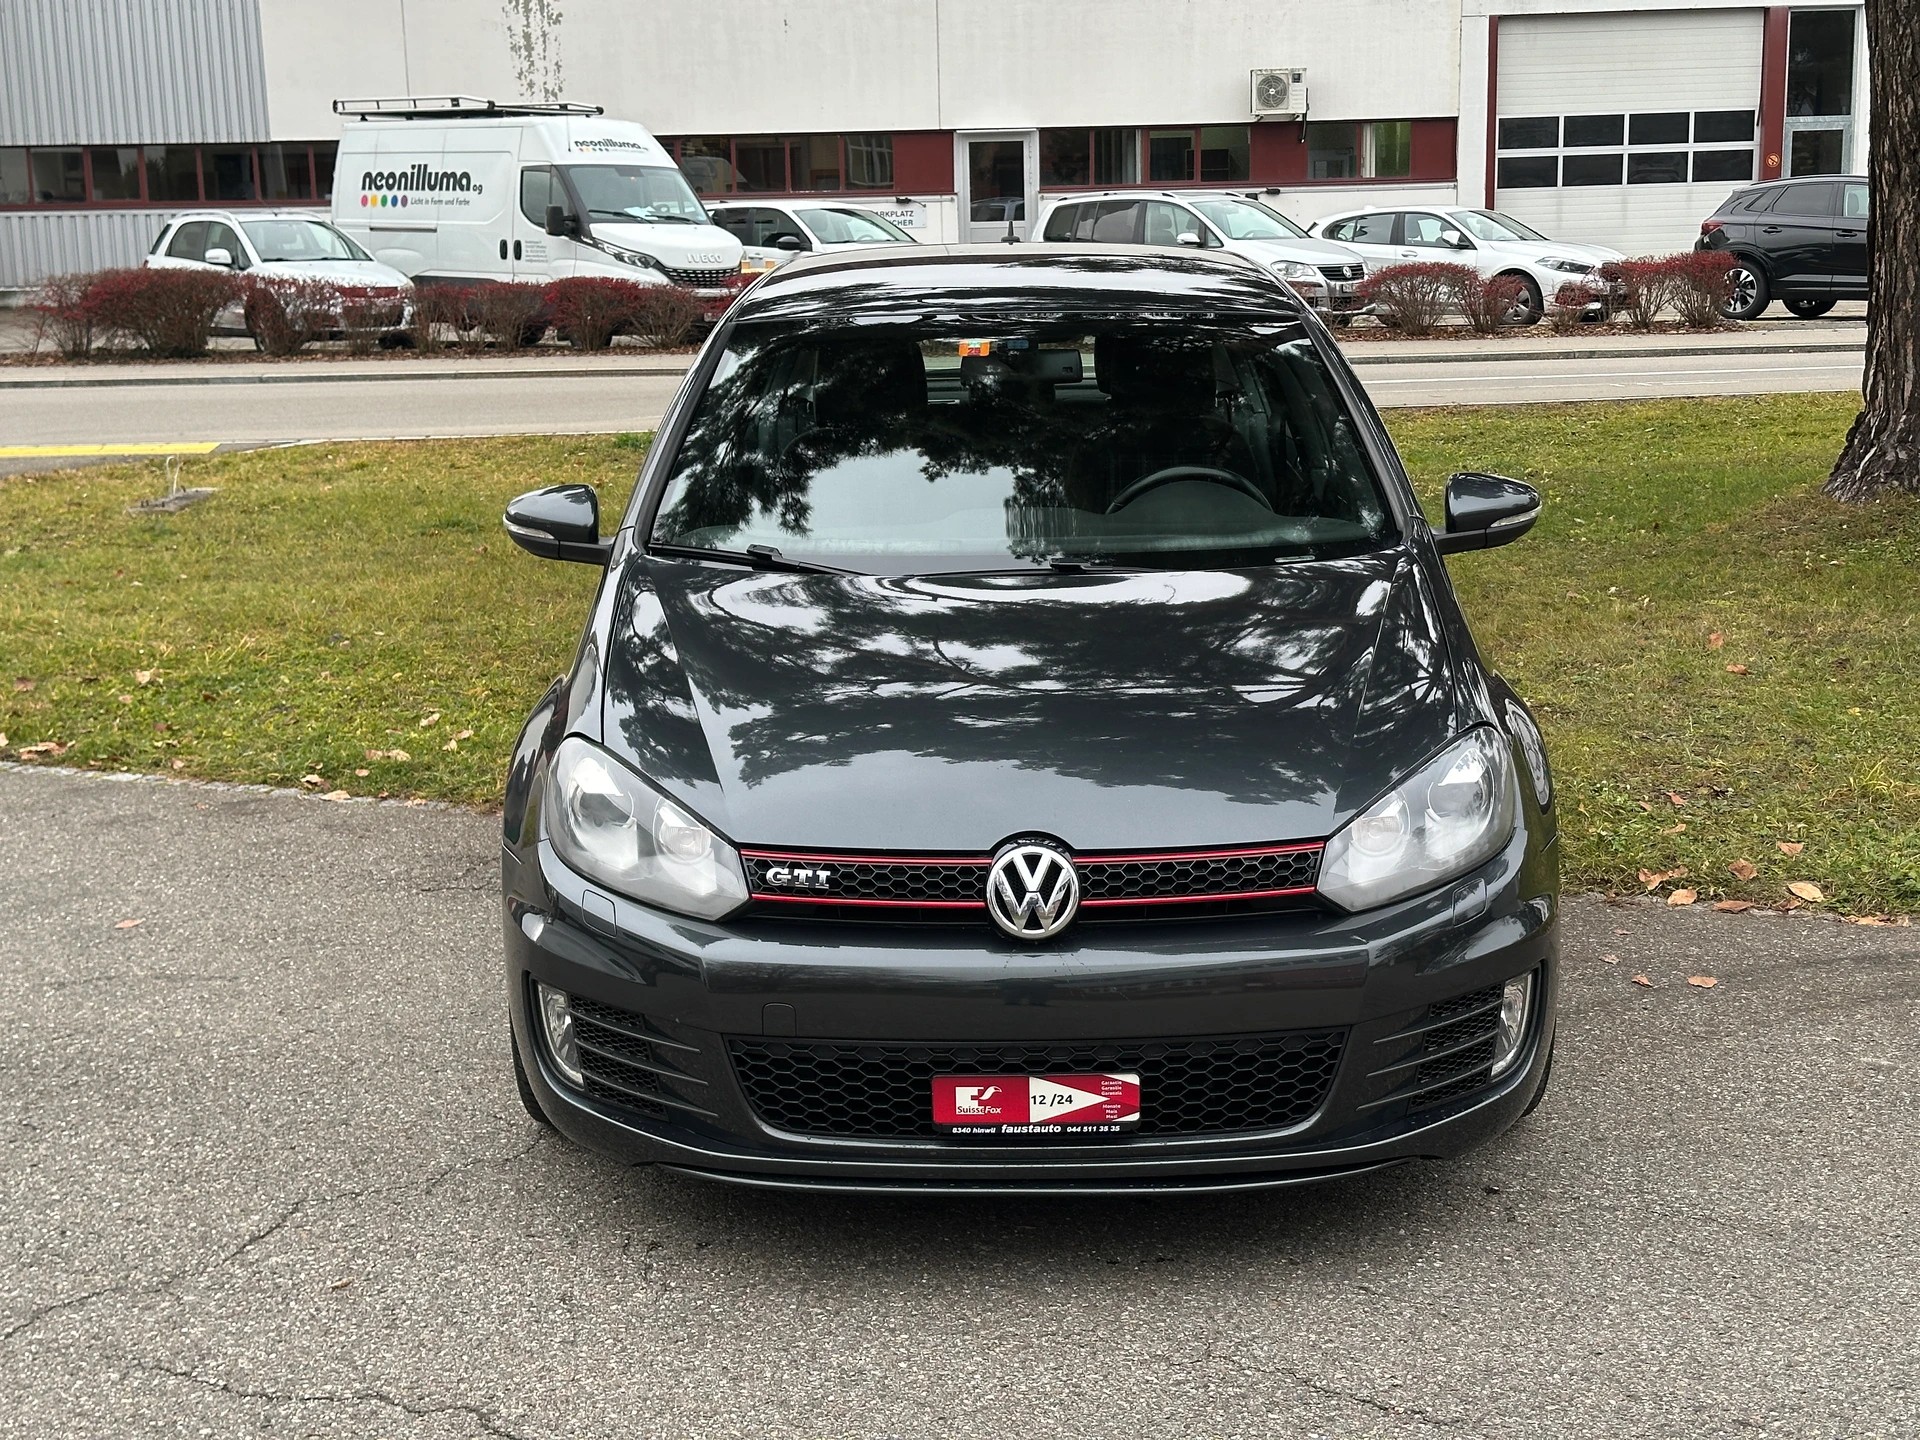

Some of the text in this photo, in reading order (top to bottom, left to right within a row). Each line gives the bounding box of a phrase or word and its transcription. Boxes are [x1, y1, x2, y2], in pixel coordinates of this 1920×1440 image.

[361, 163, 471, 191] neonilluma
[444, 198, 454, 206] und
[687, 252, 724, 264] IVECO
[765, 867, 831, 889] GTI
[1030, 1094, 1047, 1105] 12
[1001, 1124, 1062, 1133] faustauto
